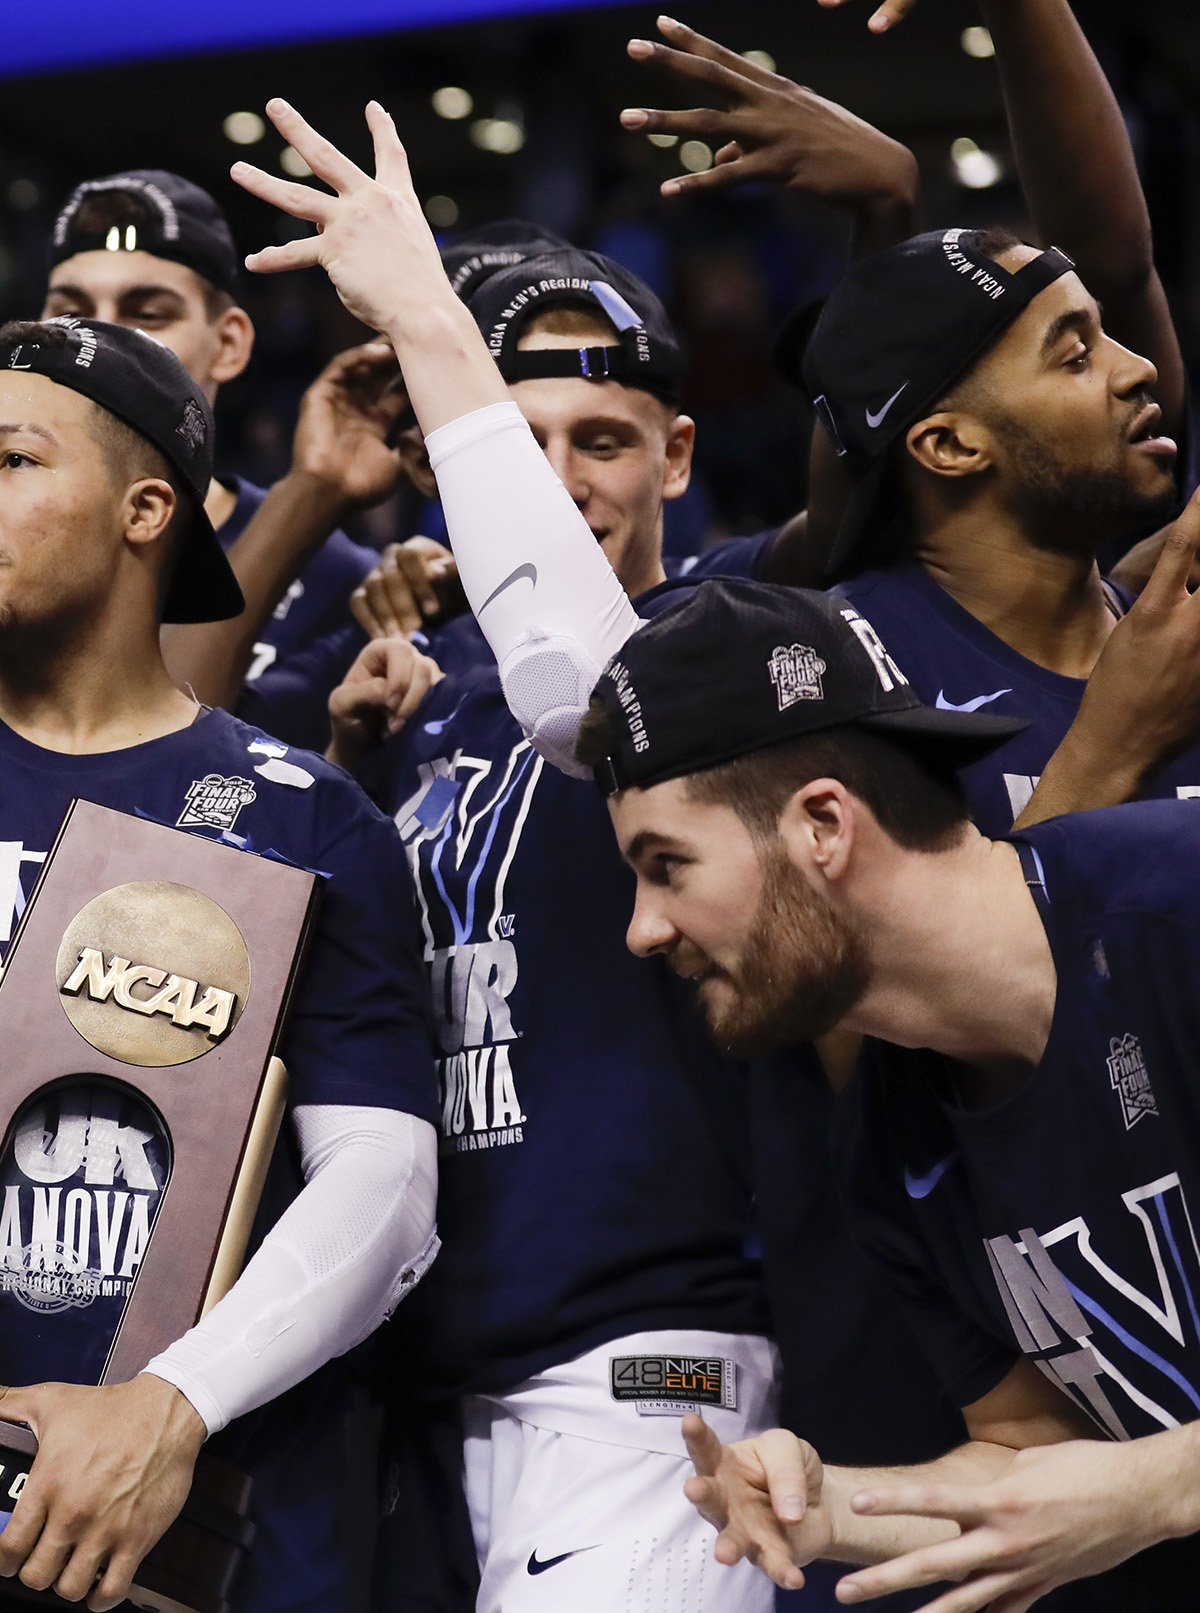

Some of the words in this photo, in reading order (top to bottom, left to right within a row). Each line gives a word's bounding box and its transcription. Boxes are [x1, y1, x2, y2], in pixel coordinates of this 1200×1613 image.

[942, 243, 976, 275] MEN'S
[971, 268, 1006, 300] NCAA
[501, 286, 539, 319] MEN'S
[538, 276, 594, 293] REGION
[772, 653, 814, 679] FINAL
[779, 670, 817, 688] FOUR
[189, 783, 242, 799] FINAL
[190, 796, 241, 810] FOUR
[60, 946, 239, 1045] NCAA
[983, 1227, 1094, 1354] IN
[616, 1360, 663, 1387] 48
[665, 1359, 720, 1377] NIKE
[666, 1373, 720, 1392] ELITE
